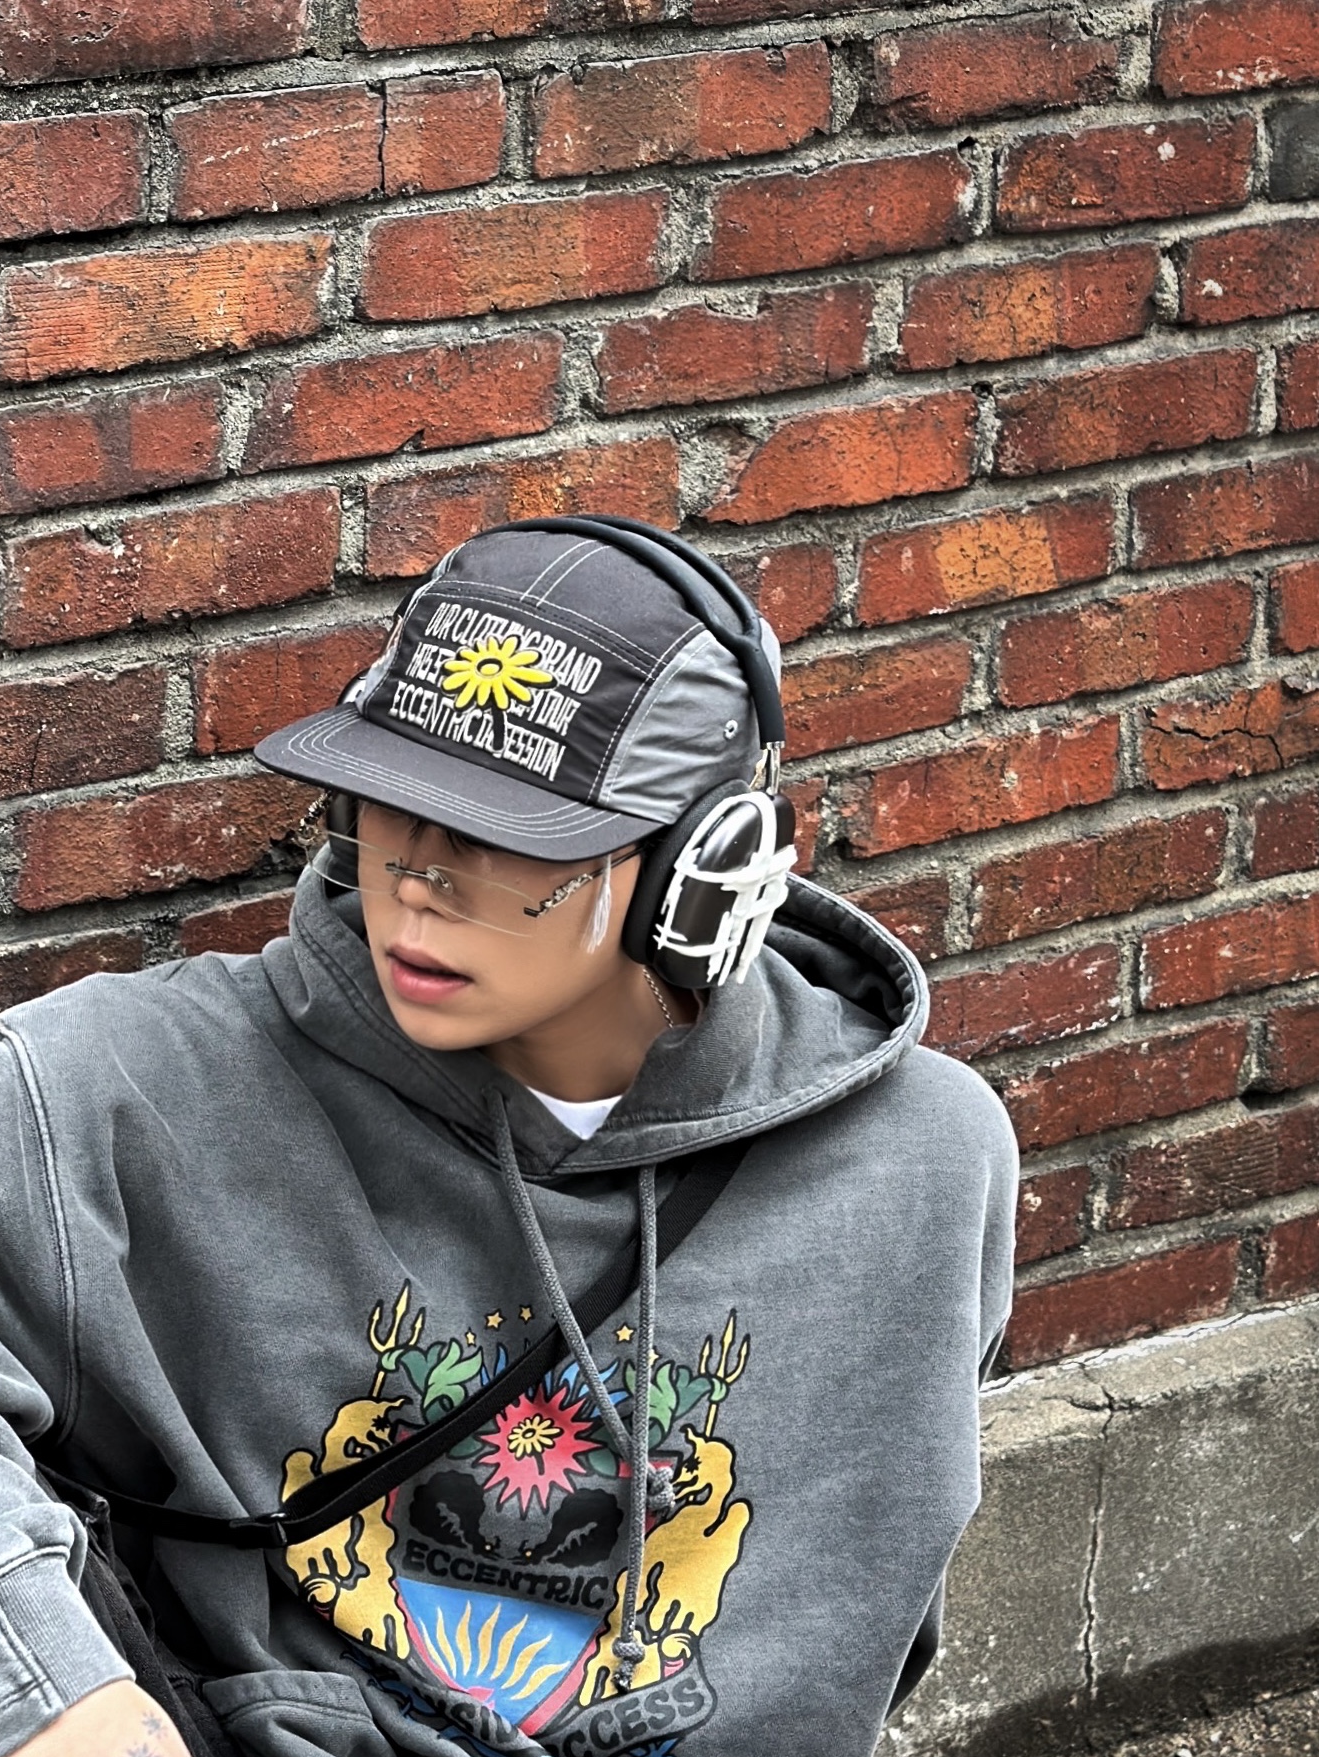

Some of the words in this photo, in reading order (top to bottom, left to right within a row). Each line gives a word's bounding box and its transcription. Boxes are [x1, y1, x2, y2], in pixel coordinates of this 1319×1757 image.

[424, 602, 461, 640] OUR
[537, 634, 603, 694] BRAND
[388, 680, 483, 743] ECCENTRIC
[527, 688, 581, 736] YOUR
[402, 1538, 609, 1609] ECCENTRIC
